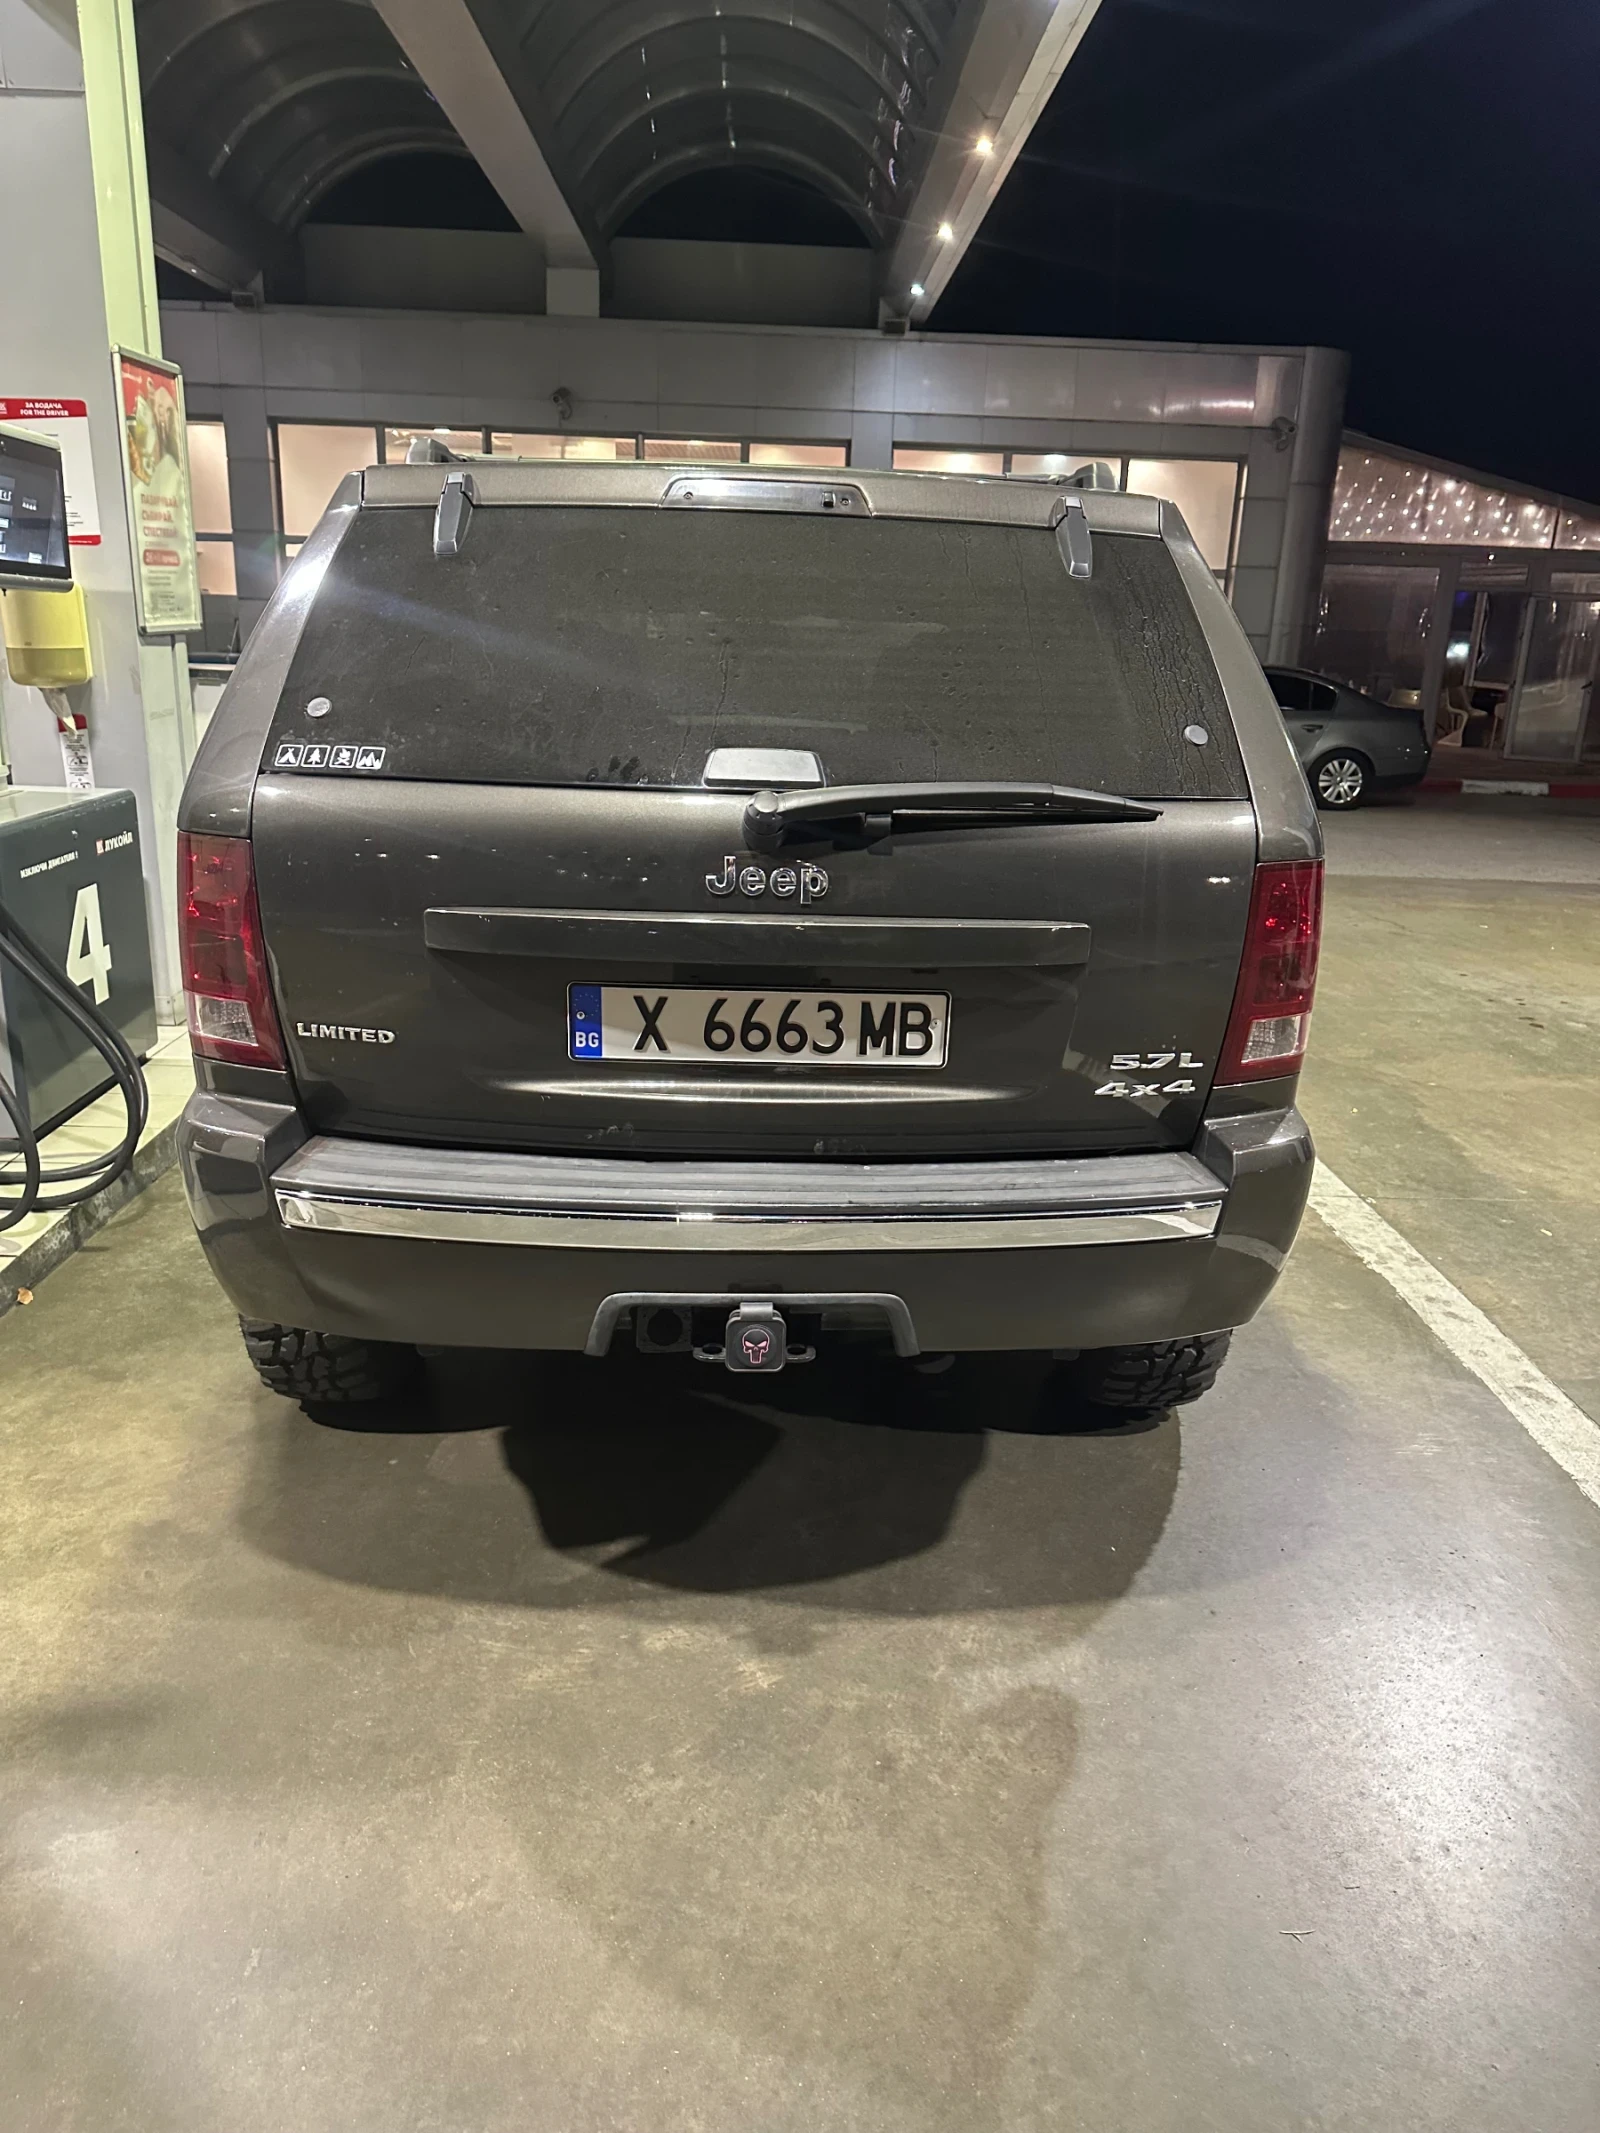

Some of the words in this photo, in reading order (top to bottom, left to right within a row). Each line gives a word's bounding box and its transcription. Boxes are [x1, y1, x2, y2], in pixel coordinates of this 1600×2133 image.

[25, 401, 34, 409] ЗА
[104, 831, 133, 852] ЛУКОЙЛ
[20, 862, 47, 878] ИЗКЛЮЧИ
[705, 856, 829, 904] Jeep
[66, 883, 112, 1005] 4
[296, 1022, 396, 1044] LIMITED
[632, 996, 671, 1053] X
[703, 998, 845, 1055] 6663
[858, 1001, 933, 1056] MB
[575, 1032, 599, 1048] BG
[1109, 1052, 1204, 1070] 5.7L
[1094, 1080, 1196, 1098] 4x4
